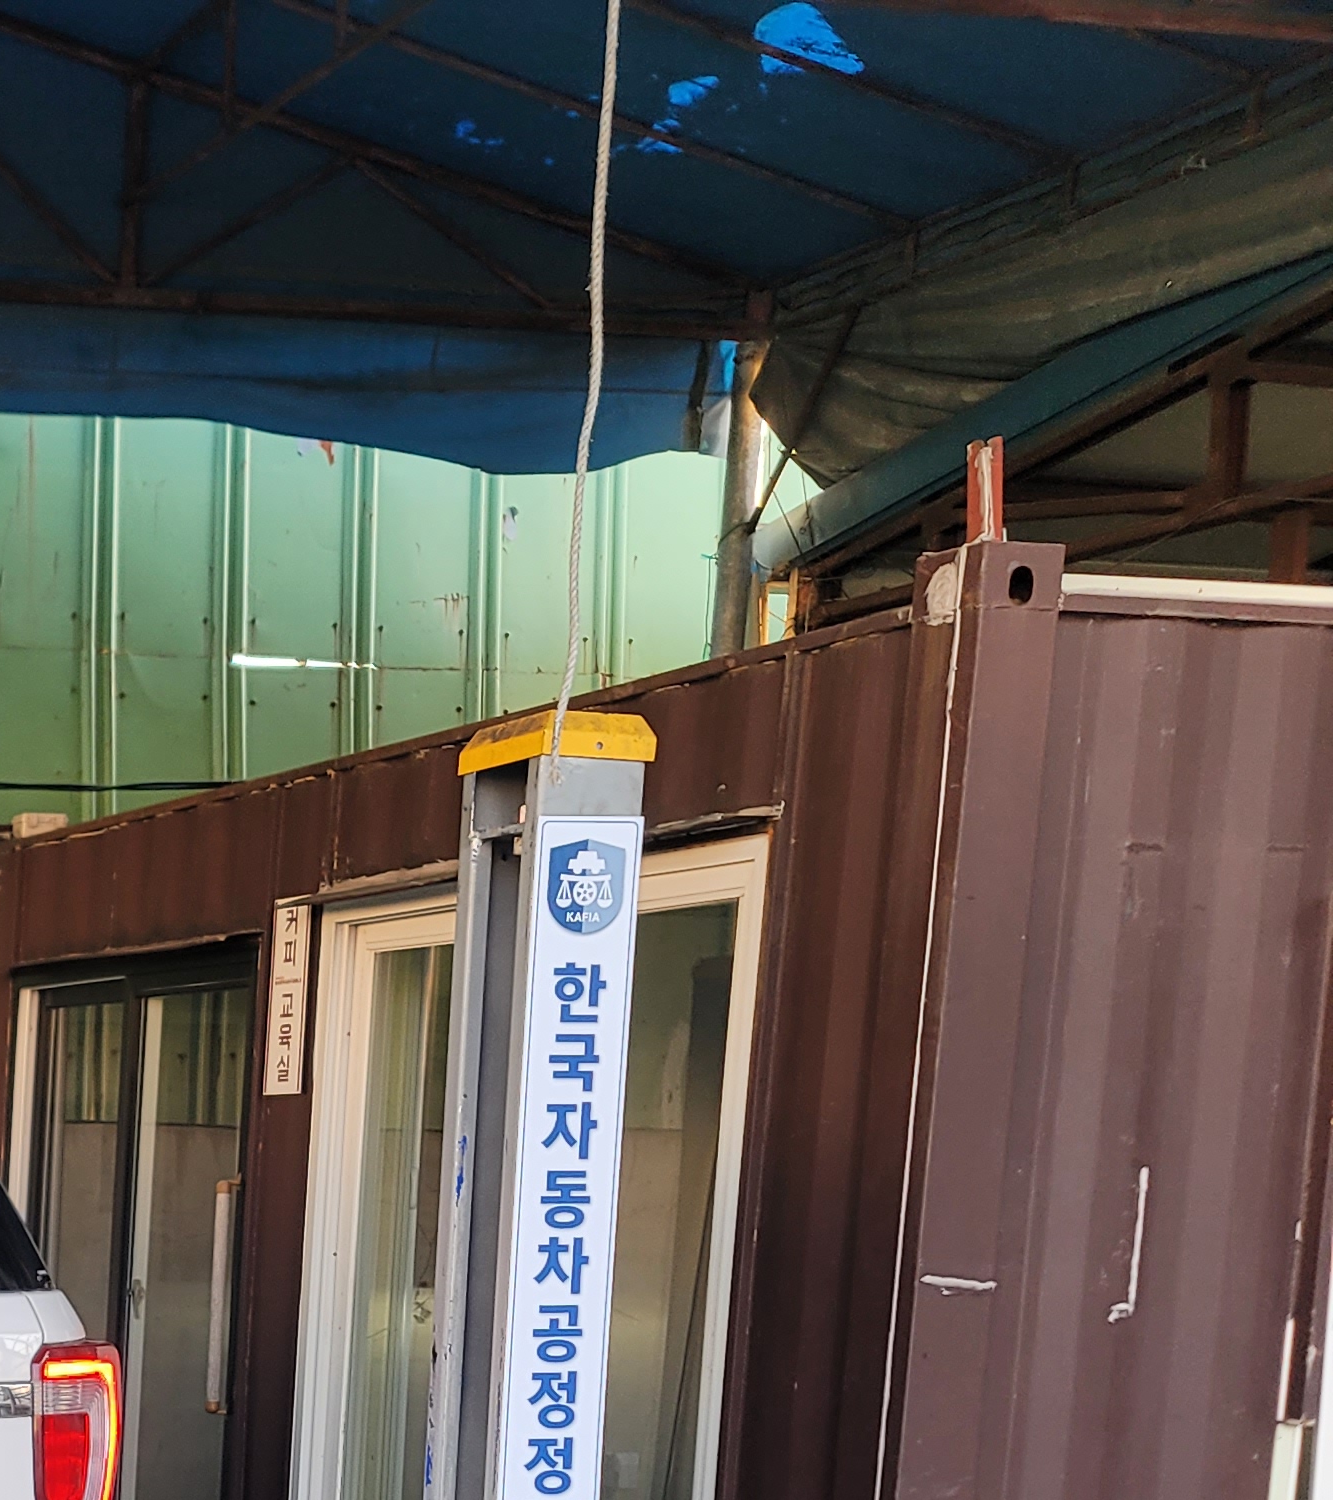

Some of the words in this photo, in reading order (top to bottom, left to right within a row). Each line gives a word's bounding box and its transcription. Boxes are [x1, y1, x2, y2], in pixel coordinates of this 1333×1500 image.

[282, 908, 299, 967] 커피
[565, 911, 601, 923] KAFIA
[276, 993, 294, 1083] 교육실
